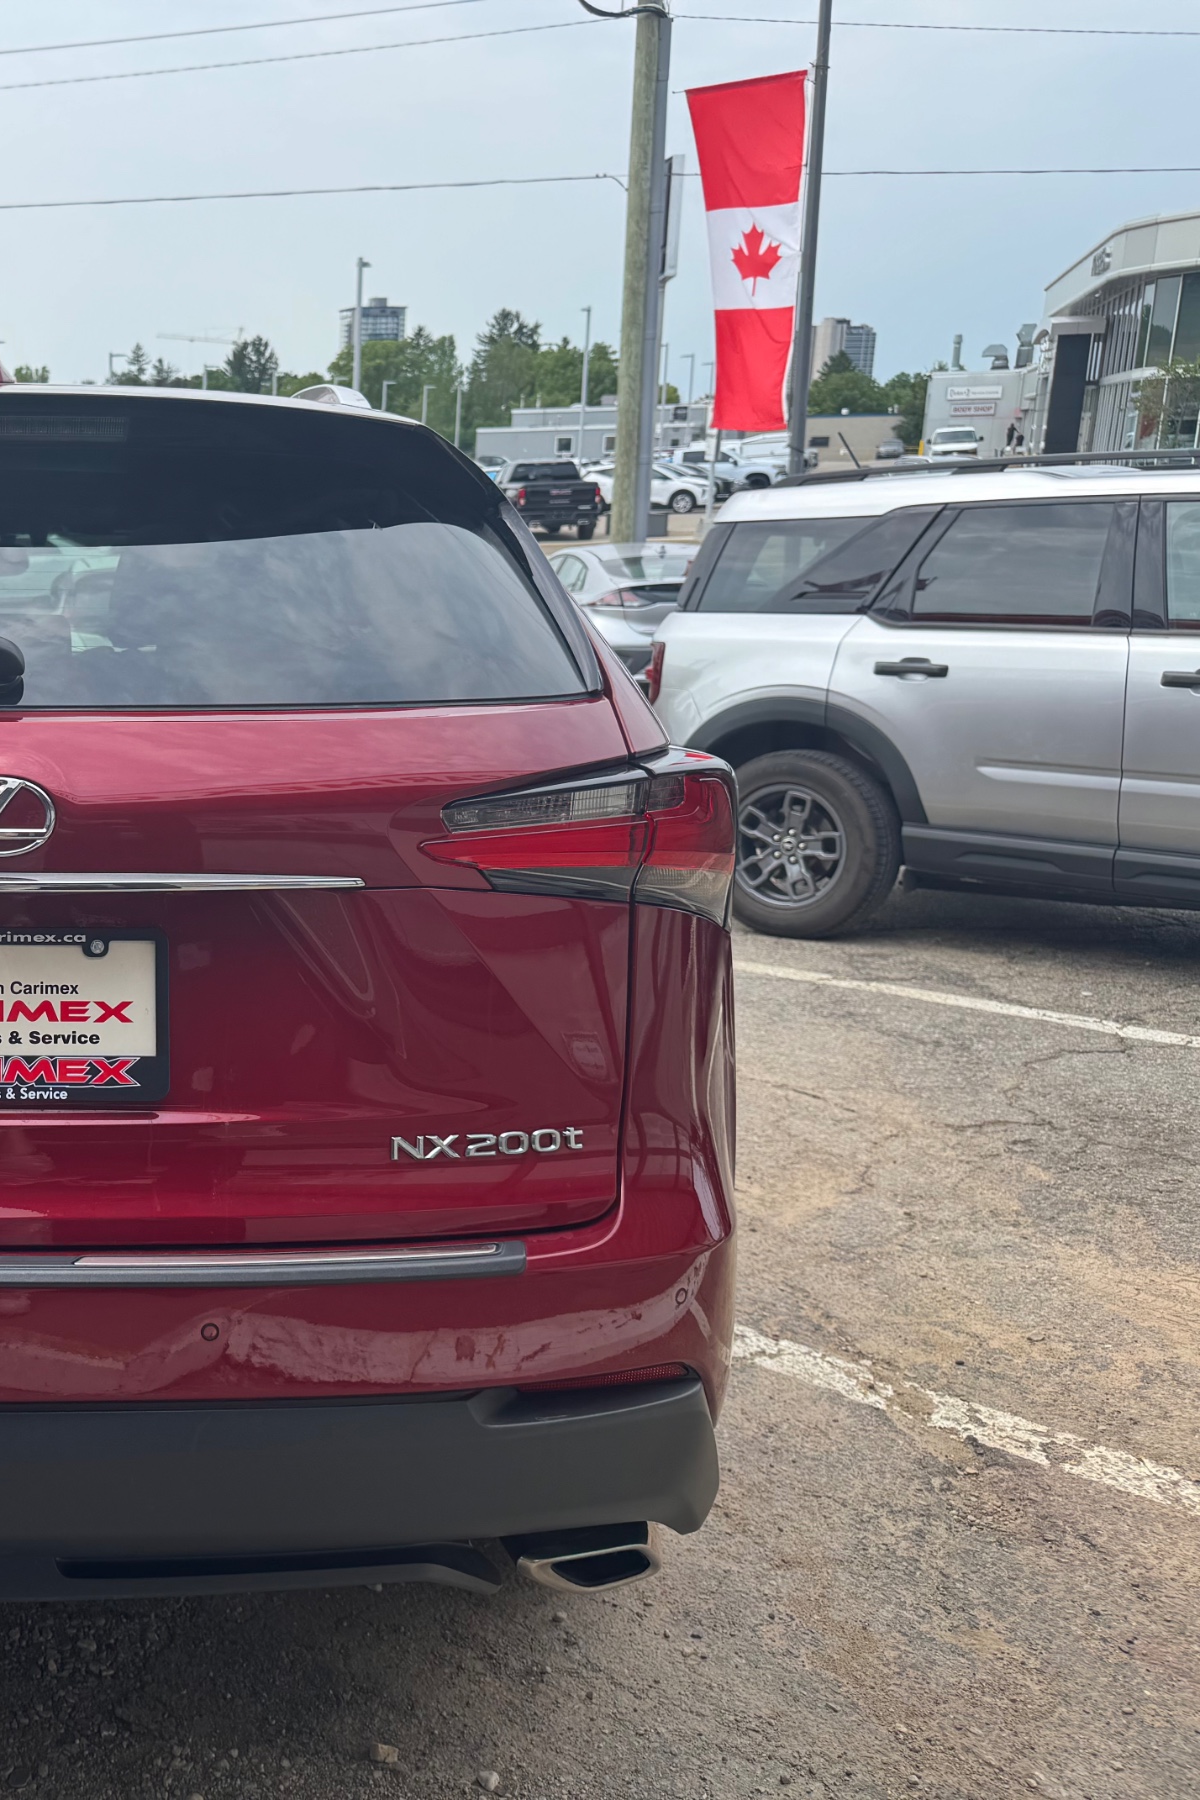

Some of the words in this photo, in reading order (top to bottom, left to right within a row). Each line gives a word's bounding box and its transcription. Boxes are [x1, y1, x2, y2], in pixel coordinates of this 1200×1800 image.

[10, 981, 79, 996] Carimex
[8, 1031, 23, 1045] &
[28, 1031, 101, 1045] Service
[6, 1087, 16, 1100] &
[20, 1087, 68, 1100] Service
